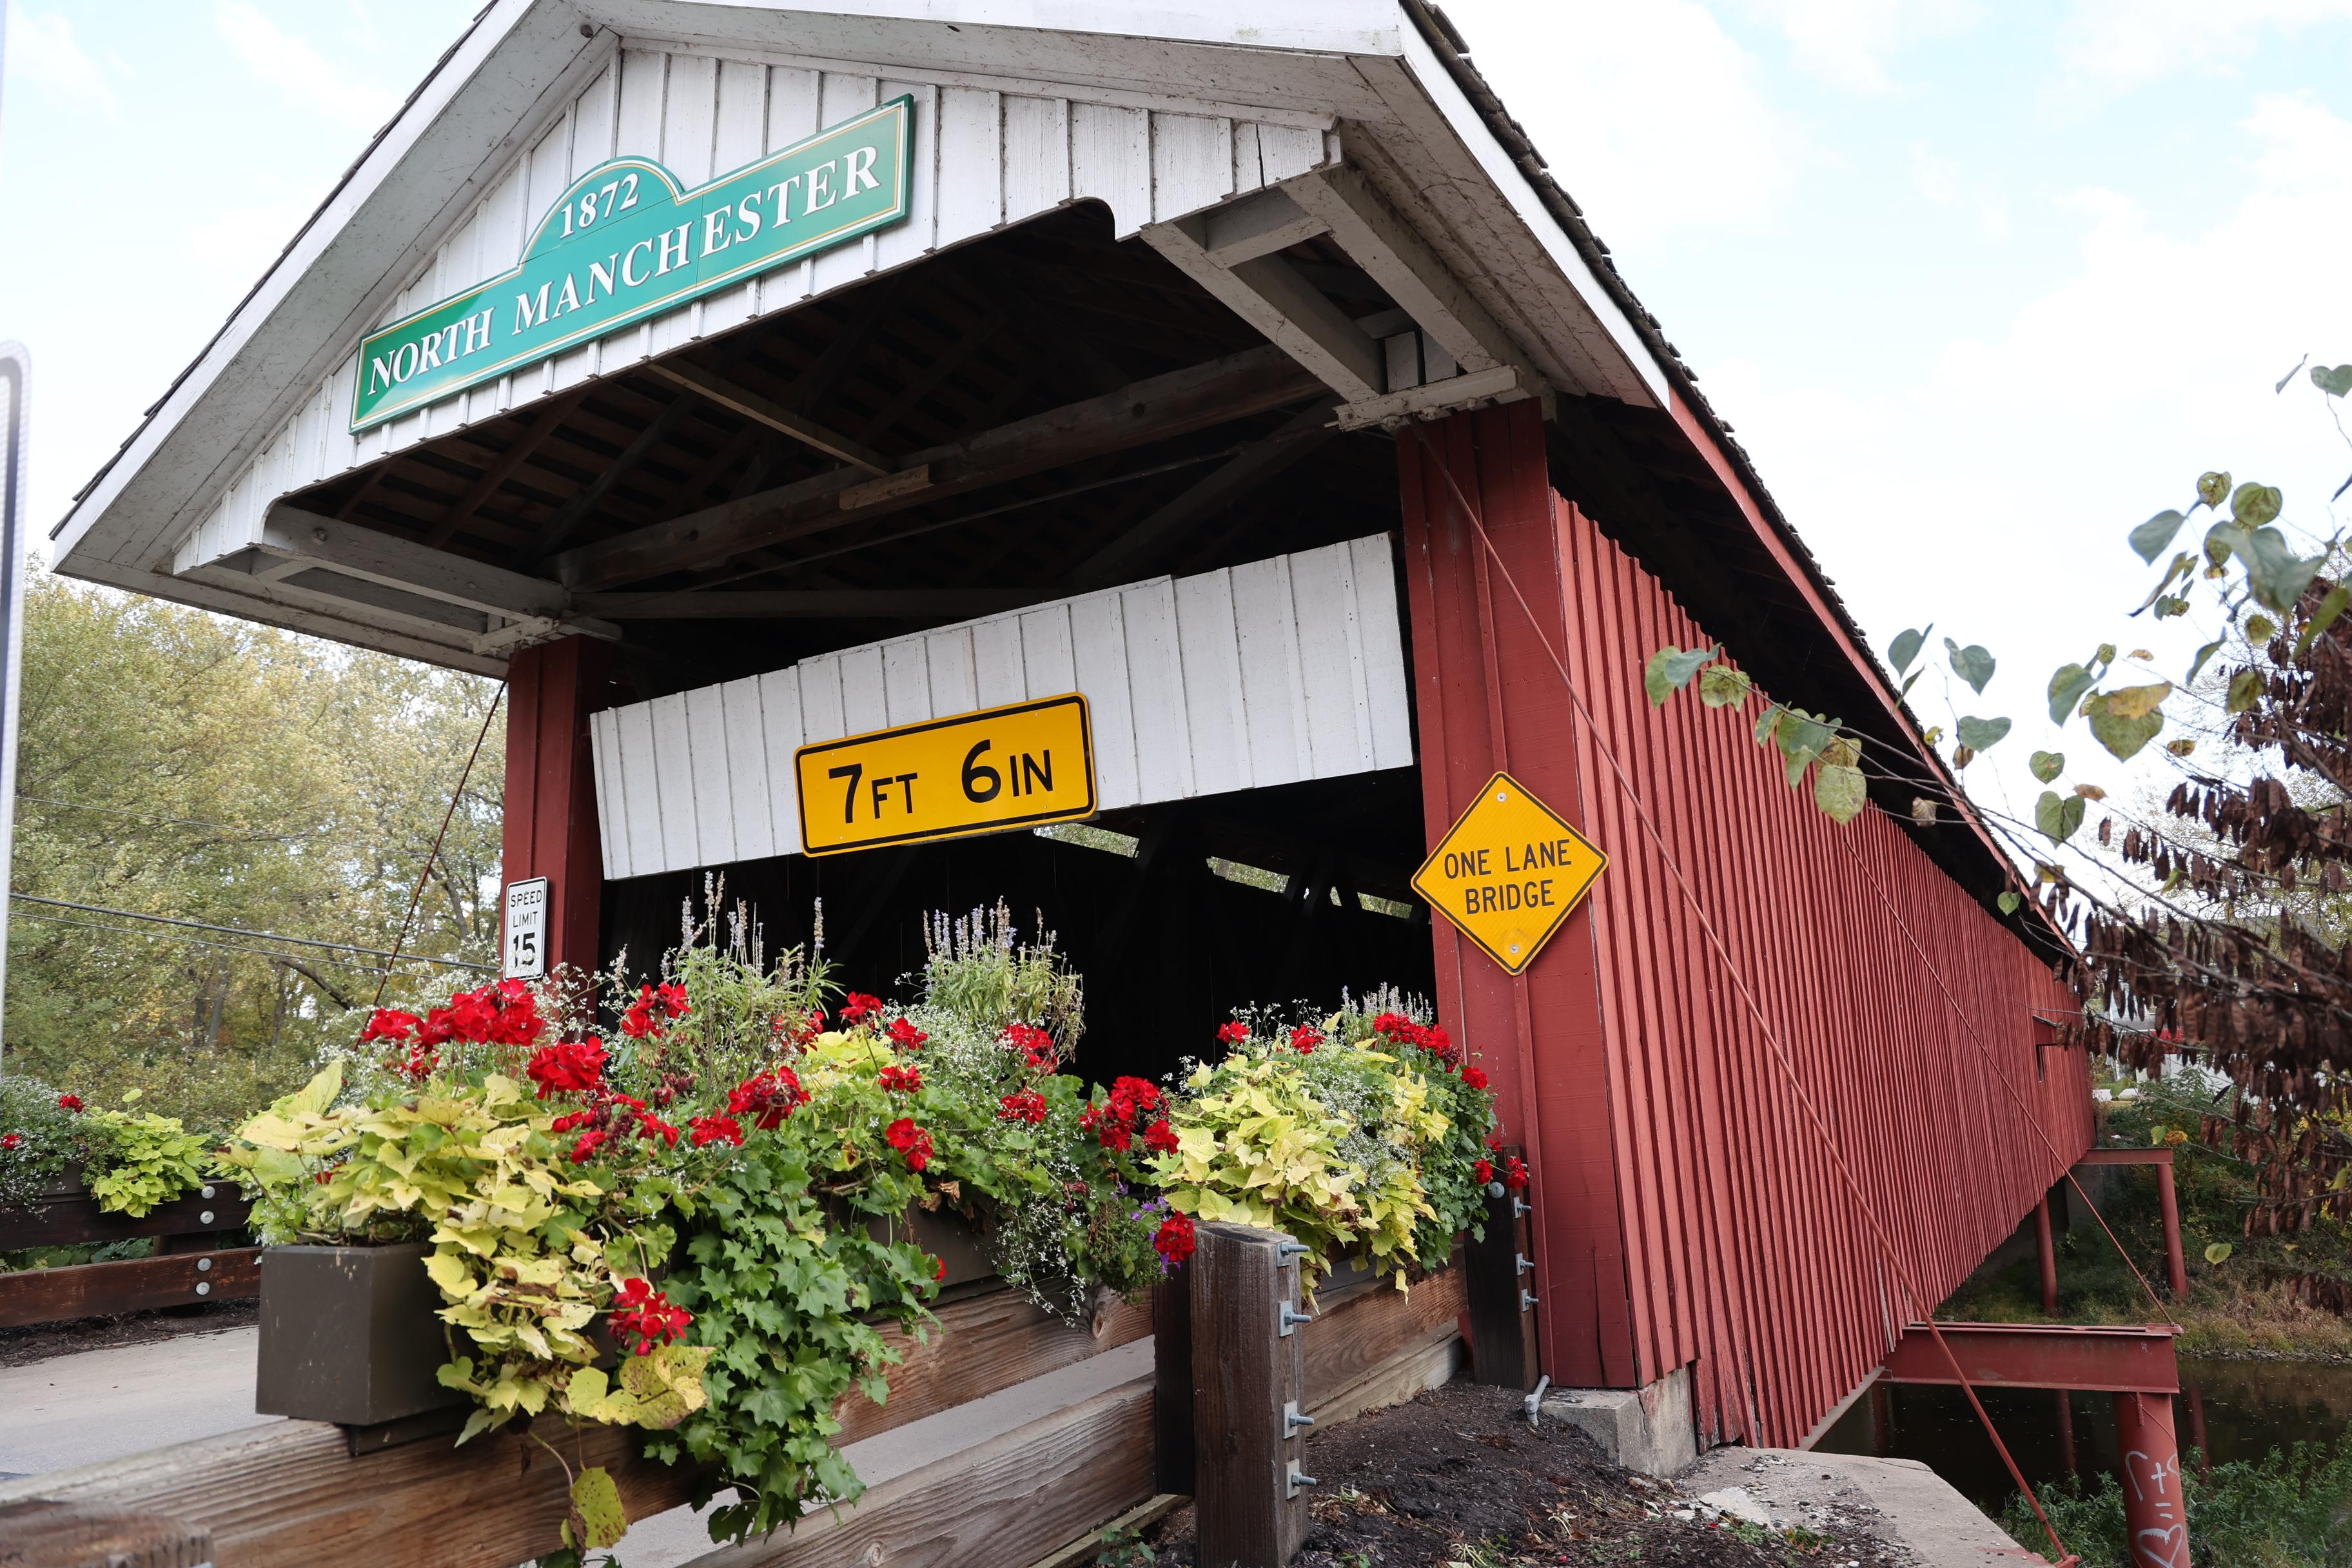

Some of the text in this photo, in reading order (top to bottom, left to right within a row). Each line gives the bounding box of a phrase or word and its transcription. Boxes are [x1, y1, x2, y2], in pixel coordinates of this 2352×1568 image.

[560, 173, 640, 239] 1872
[367, 145, 881, 396] NORTH MANCHESTER
[1444, 839, 1572, 879] ONE LANE
[510, 890, 542, 908] SPEED
[1465, 879, 1555, 915] BRIDGE
[513, 911, 538, 928] LIMIT
[513, 932, 536, 968] 15
